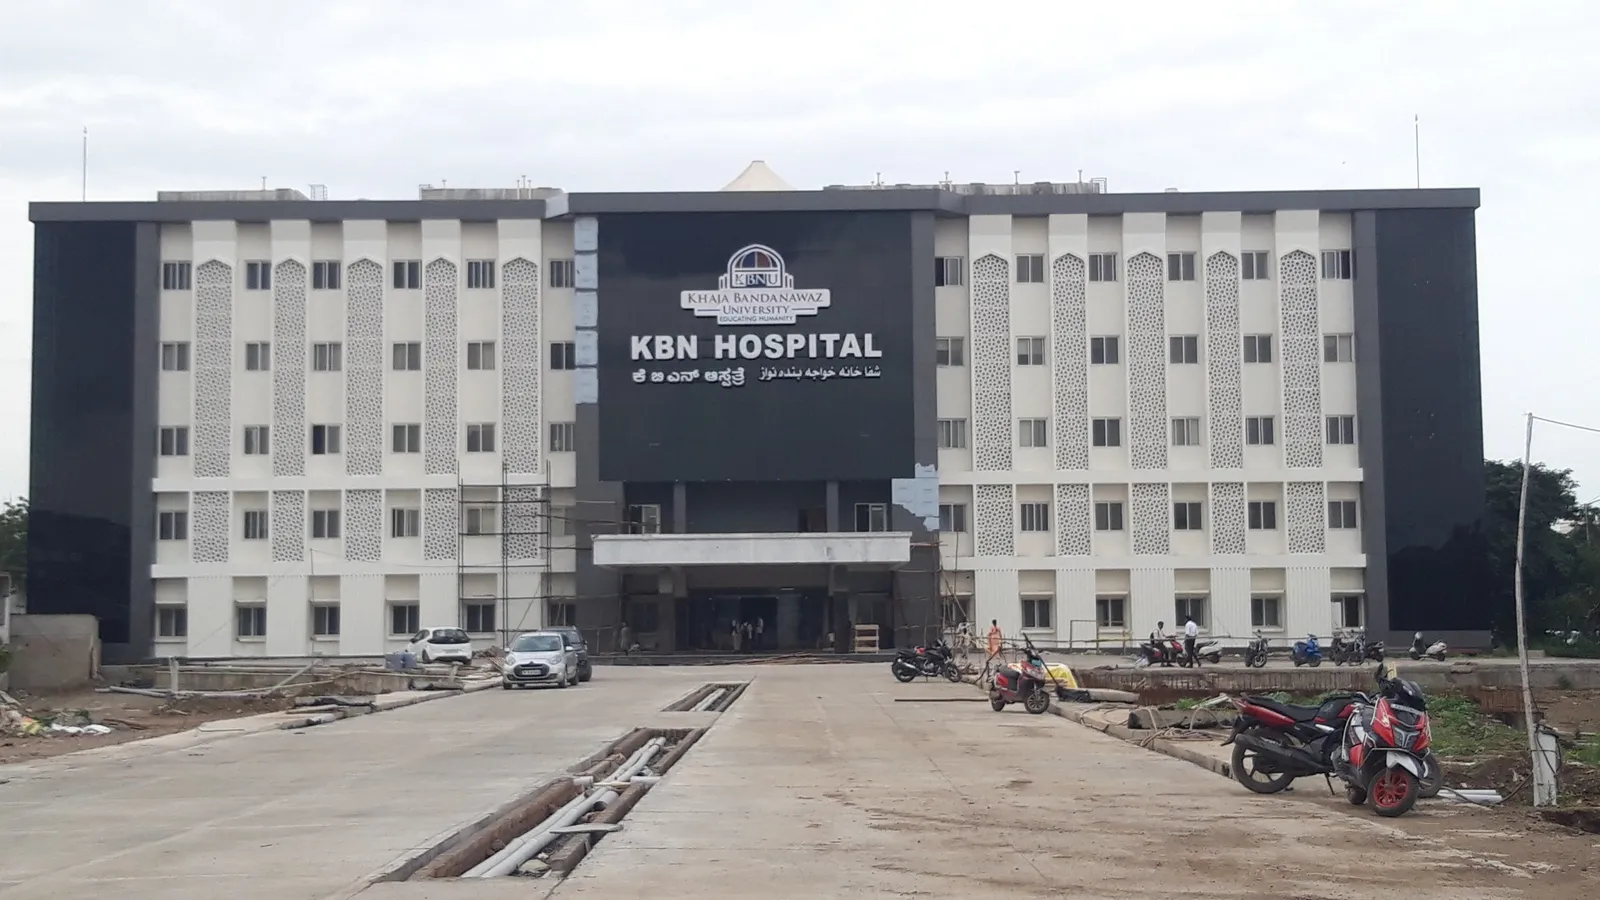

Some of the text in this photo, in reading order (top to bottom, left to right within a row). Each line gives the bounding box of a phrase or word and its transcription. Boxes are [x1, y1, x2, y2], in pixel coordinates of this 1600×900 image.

[735, 273, 778, 286] KBNU
[687, 292, 823, 304] KHAJA BANDANAWAZ
[723, 305, 790, 315] UNIVERSITY
[631, 333, 883, 360] KBN HOSPITAL
